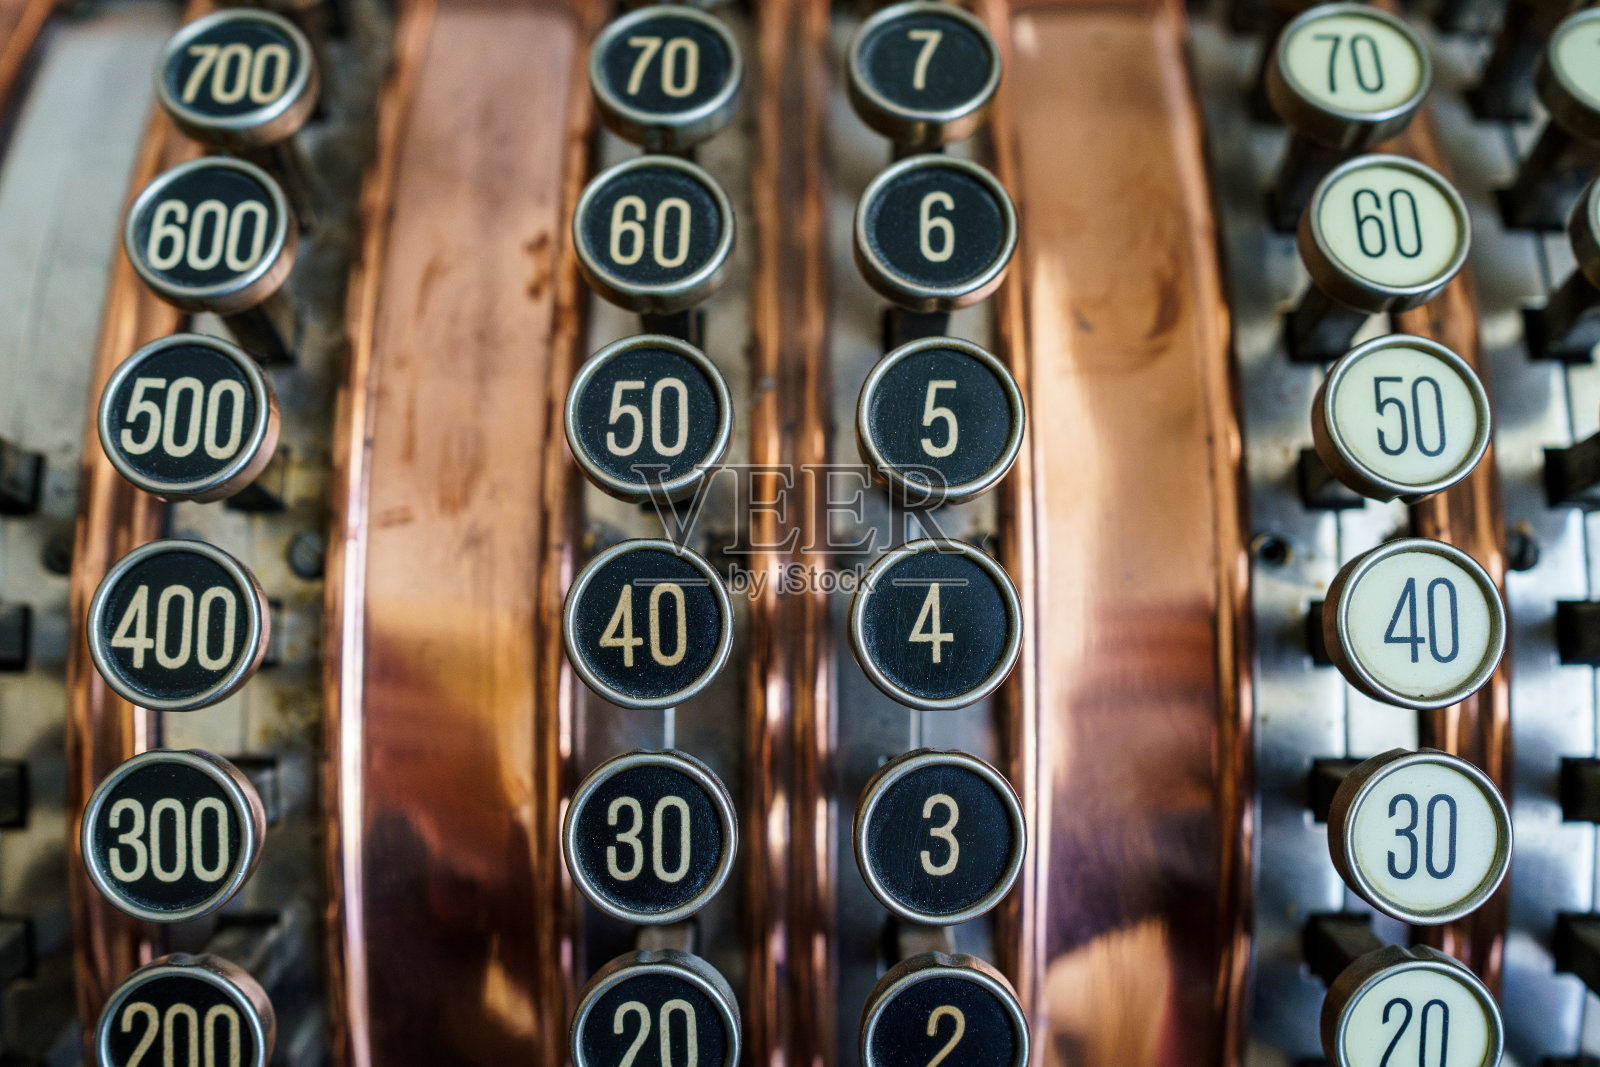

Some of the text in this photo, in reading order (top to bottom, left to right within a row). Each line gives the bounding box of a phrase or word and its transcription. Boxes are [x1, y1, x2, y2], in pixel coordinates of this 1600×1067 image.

[182, 43, 290, 104] 700
[628, 37, 698, 97] 70
[909, 30, 942, 89] 7
[1312, 33, 1385, 95] 70
[148, 199, 267, 271] 600
[610, 196, 691, 267] 60
[920, 192, 954, 262] 6
[1352, 189, 1422, 258] 60
[121, 377, 244, 458] 500
[607, 378, 688, 456] 50
[921, 380, 958, 458] 5
[1374, 376, 1446, 457] 50
[111, 584, 236, 671] 400
[600, 581, 687, 667] 40
[908, 582, 954, 663] 4
[1384, 578, 1459, 663] 40
[108, 797, 229, 883] 300
[607, 796, 690, 882] 30
[921, 794, 959, 875] 3
[1388, 794, 1457, 879] 30
[121, 1002, 240, 1067] 200
[614, 999, 698, 1067] 20
[927, 1005, 965, 1067] 2
[1379, 998, 1449, 1067] 20
